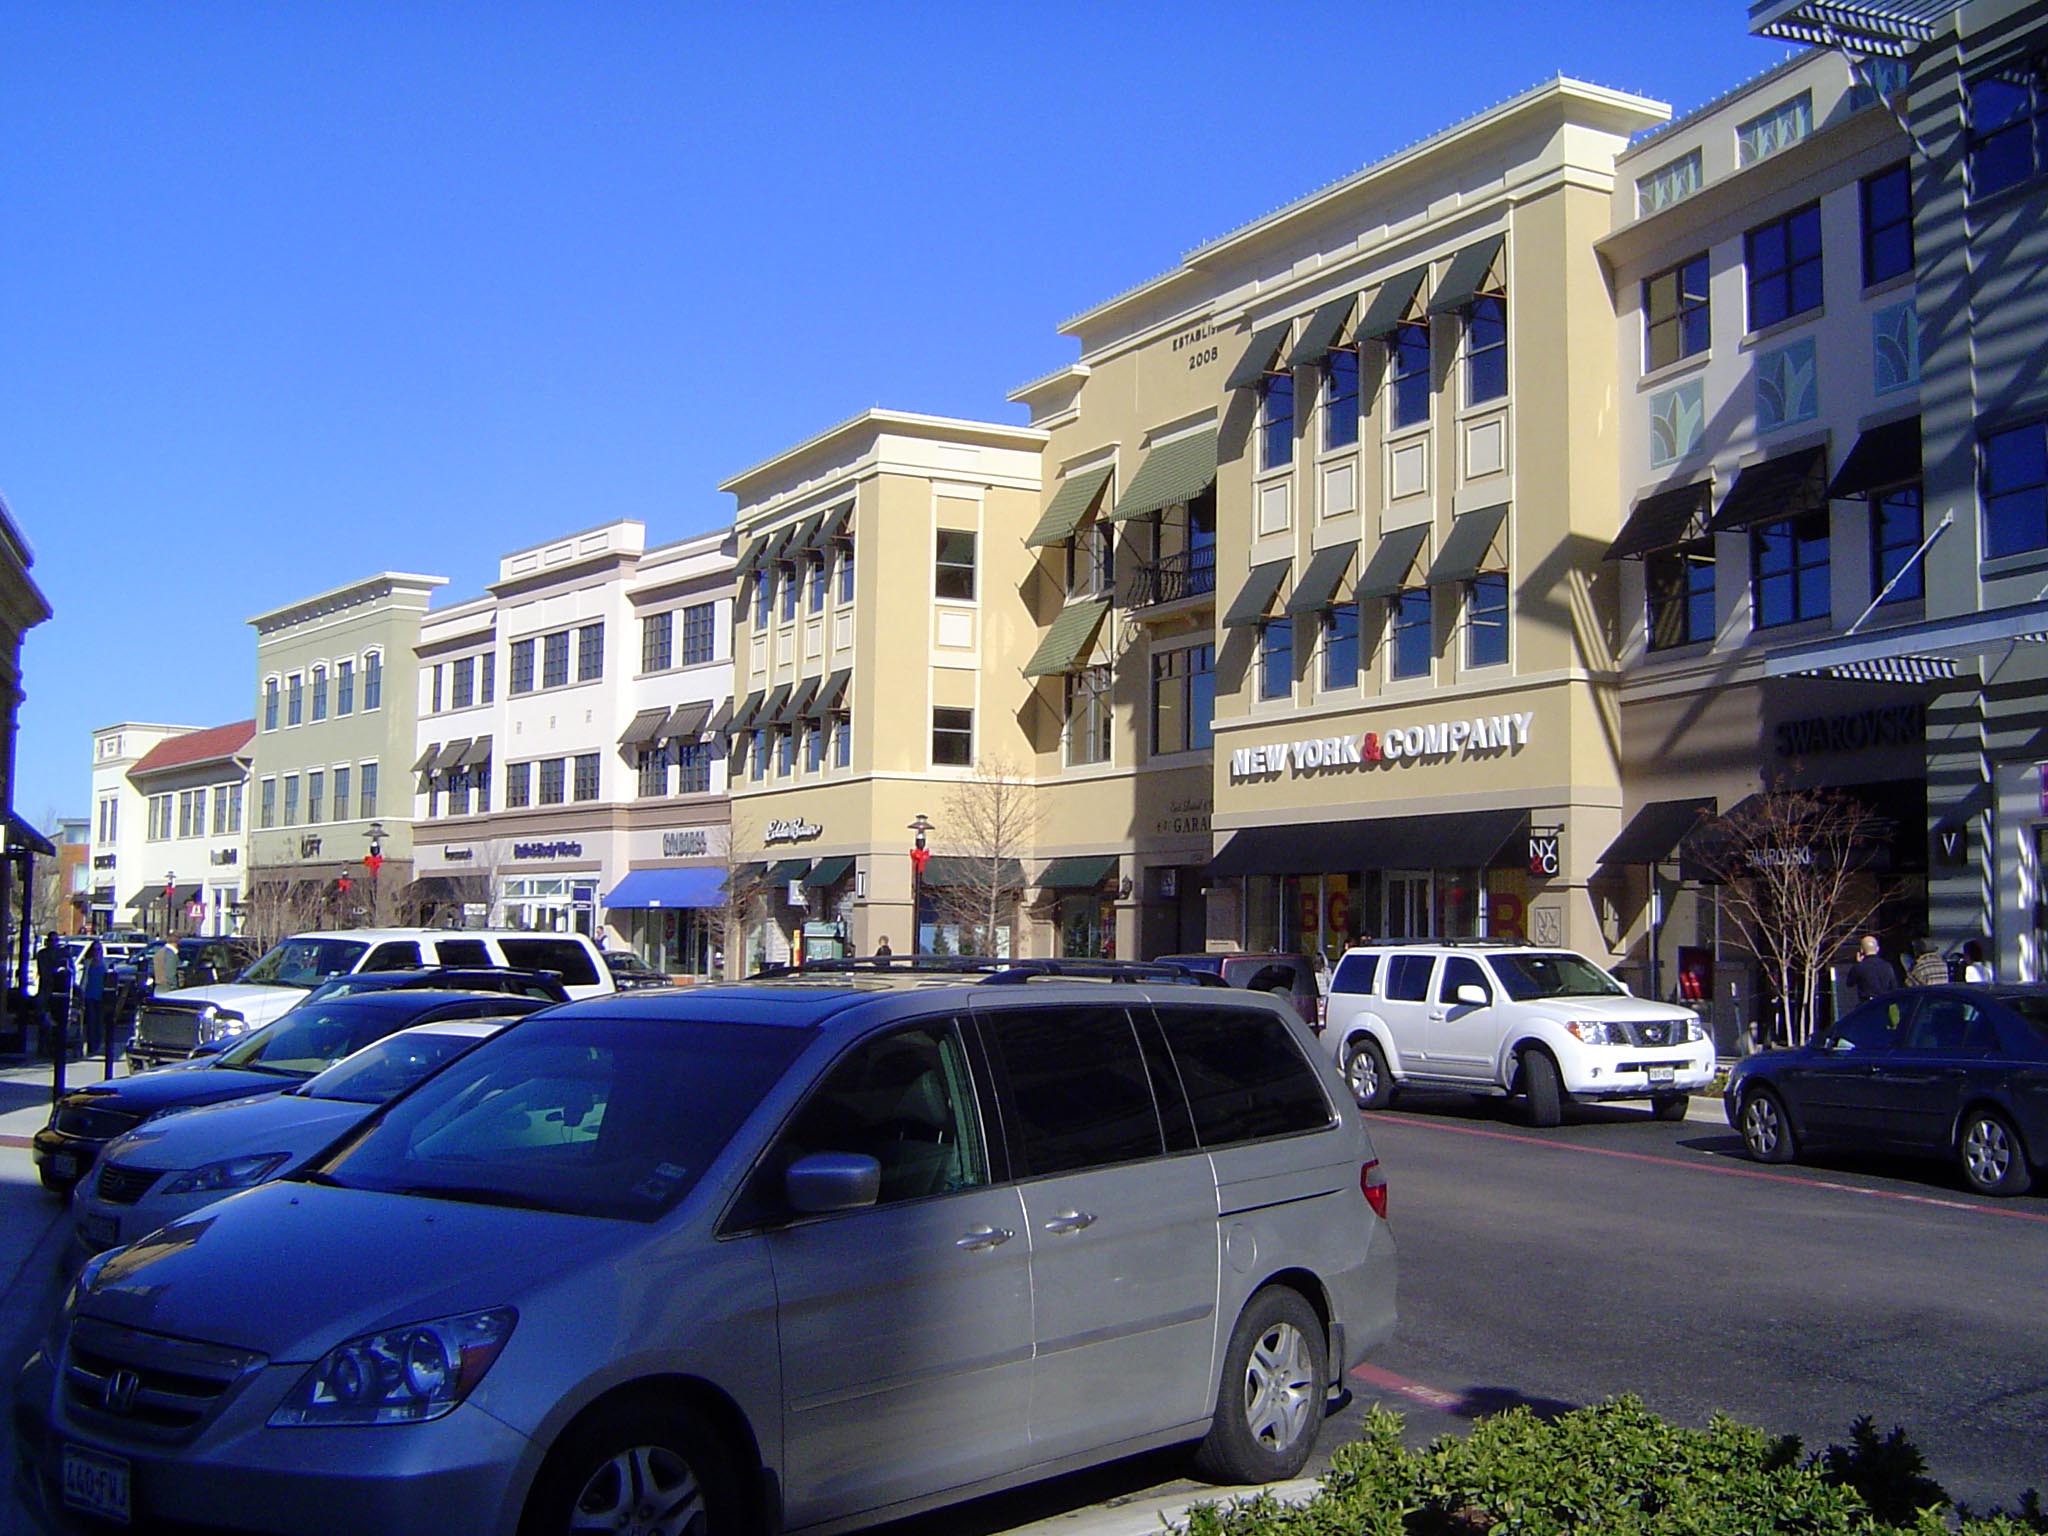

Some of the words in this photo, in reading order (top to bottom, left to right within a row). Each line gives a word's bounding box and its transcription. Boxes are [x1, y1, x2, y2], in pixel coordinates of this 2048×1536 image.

[1172, 326, 1217, 352] ESTABLIS
[1188, 346, 1218, 371] 2008
[1774, 703, 1926, 757] SWAROVSKI
[1232, 743, 1288, 776] NEW
[1288, 735, 1361, 770] YORK
[1361, 732, 1381, 761] &
[1383, 712, 1533, 760] COMPANY
[1174, 817, 1209, 833] GARA
[1529, 839, 1557, 858] NY
[1745, 845, 1811, 867] SWAROVSKI
